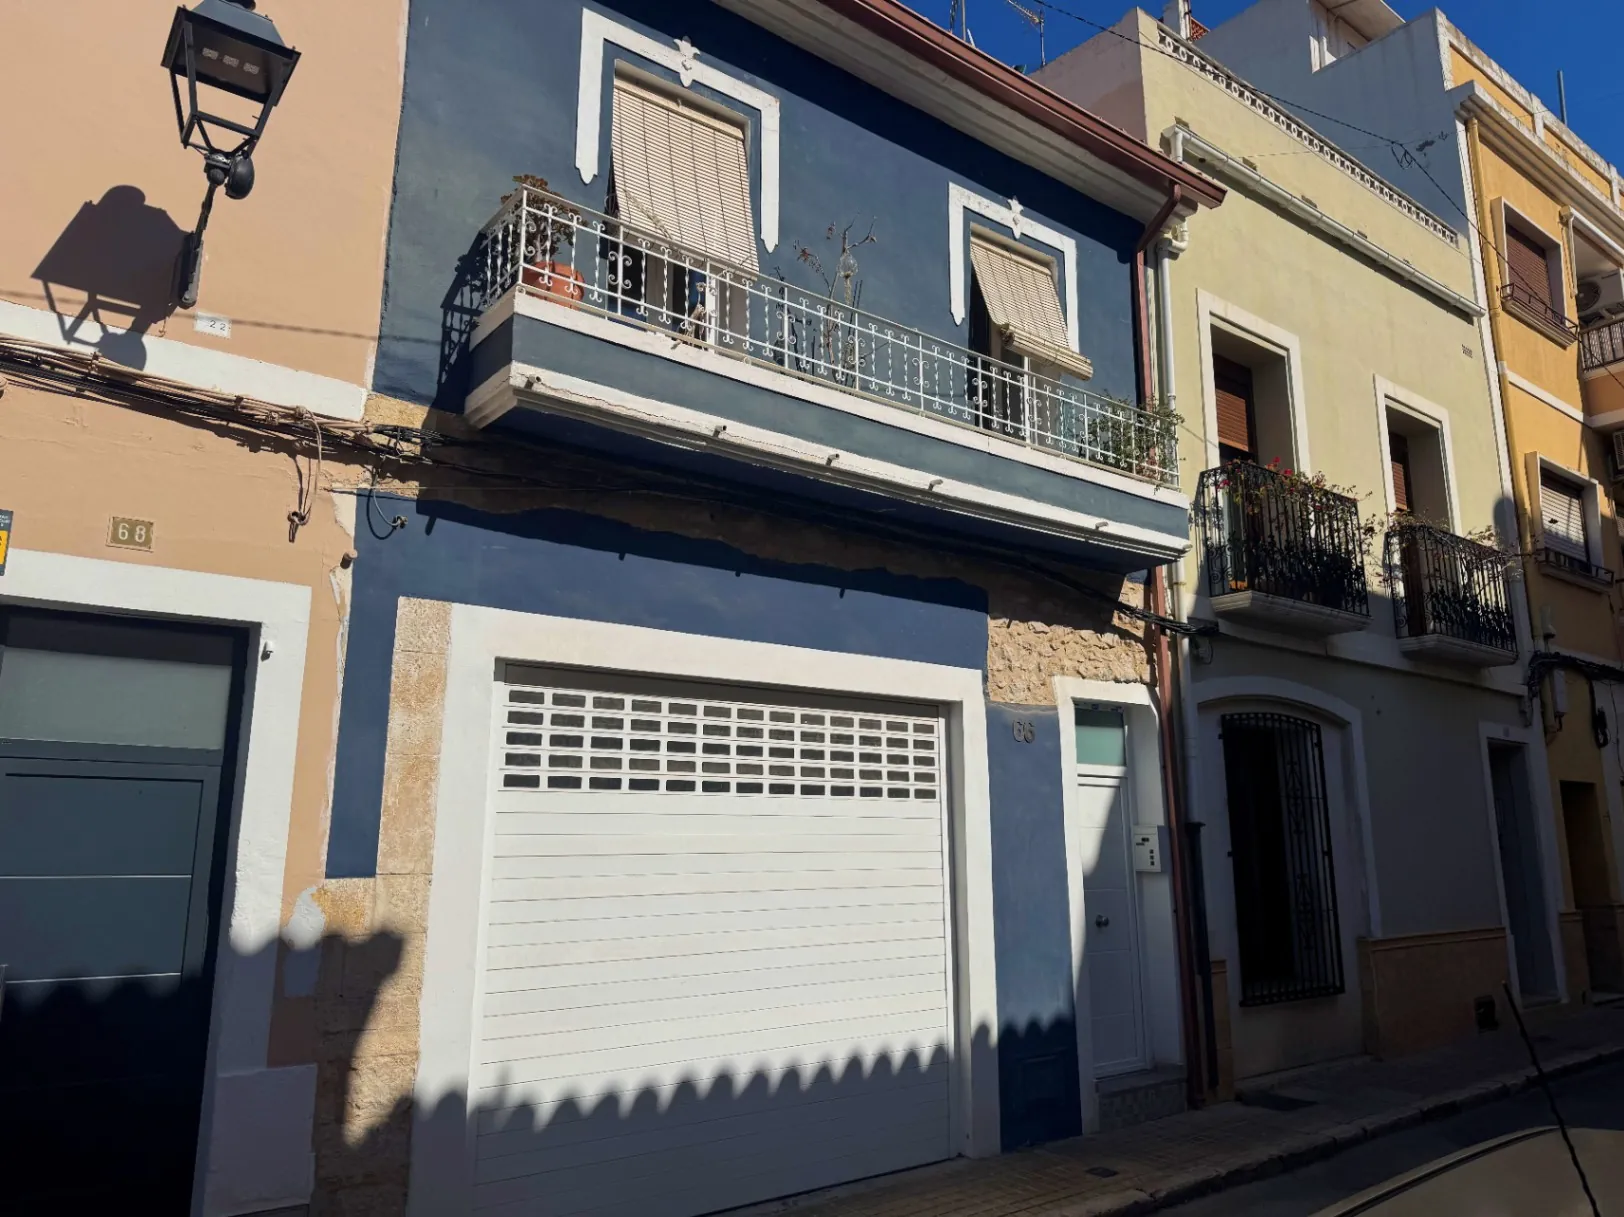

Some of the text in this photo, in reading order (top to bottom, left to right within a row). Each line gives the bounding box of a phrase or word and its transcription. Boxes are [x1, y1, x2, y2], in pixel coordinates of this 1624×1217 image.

[209, 319, 226, 331] 22
[118, 522, 146, 543] 68
[1012, 720, 1036, 744] 66
